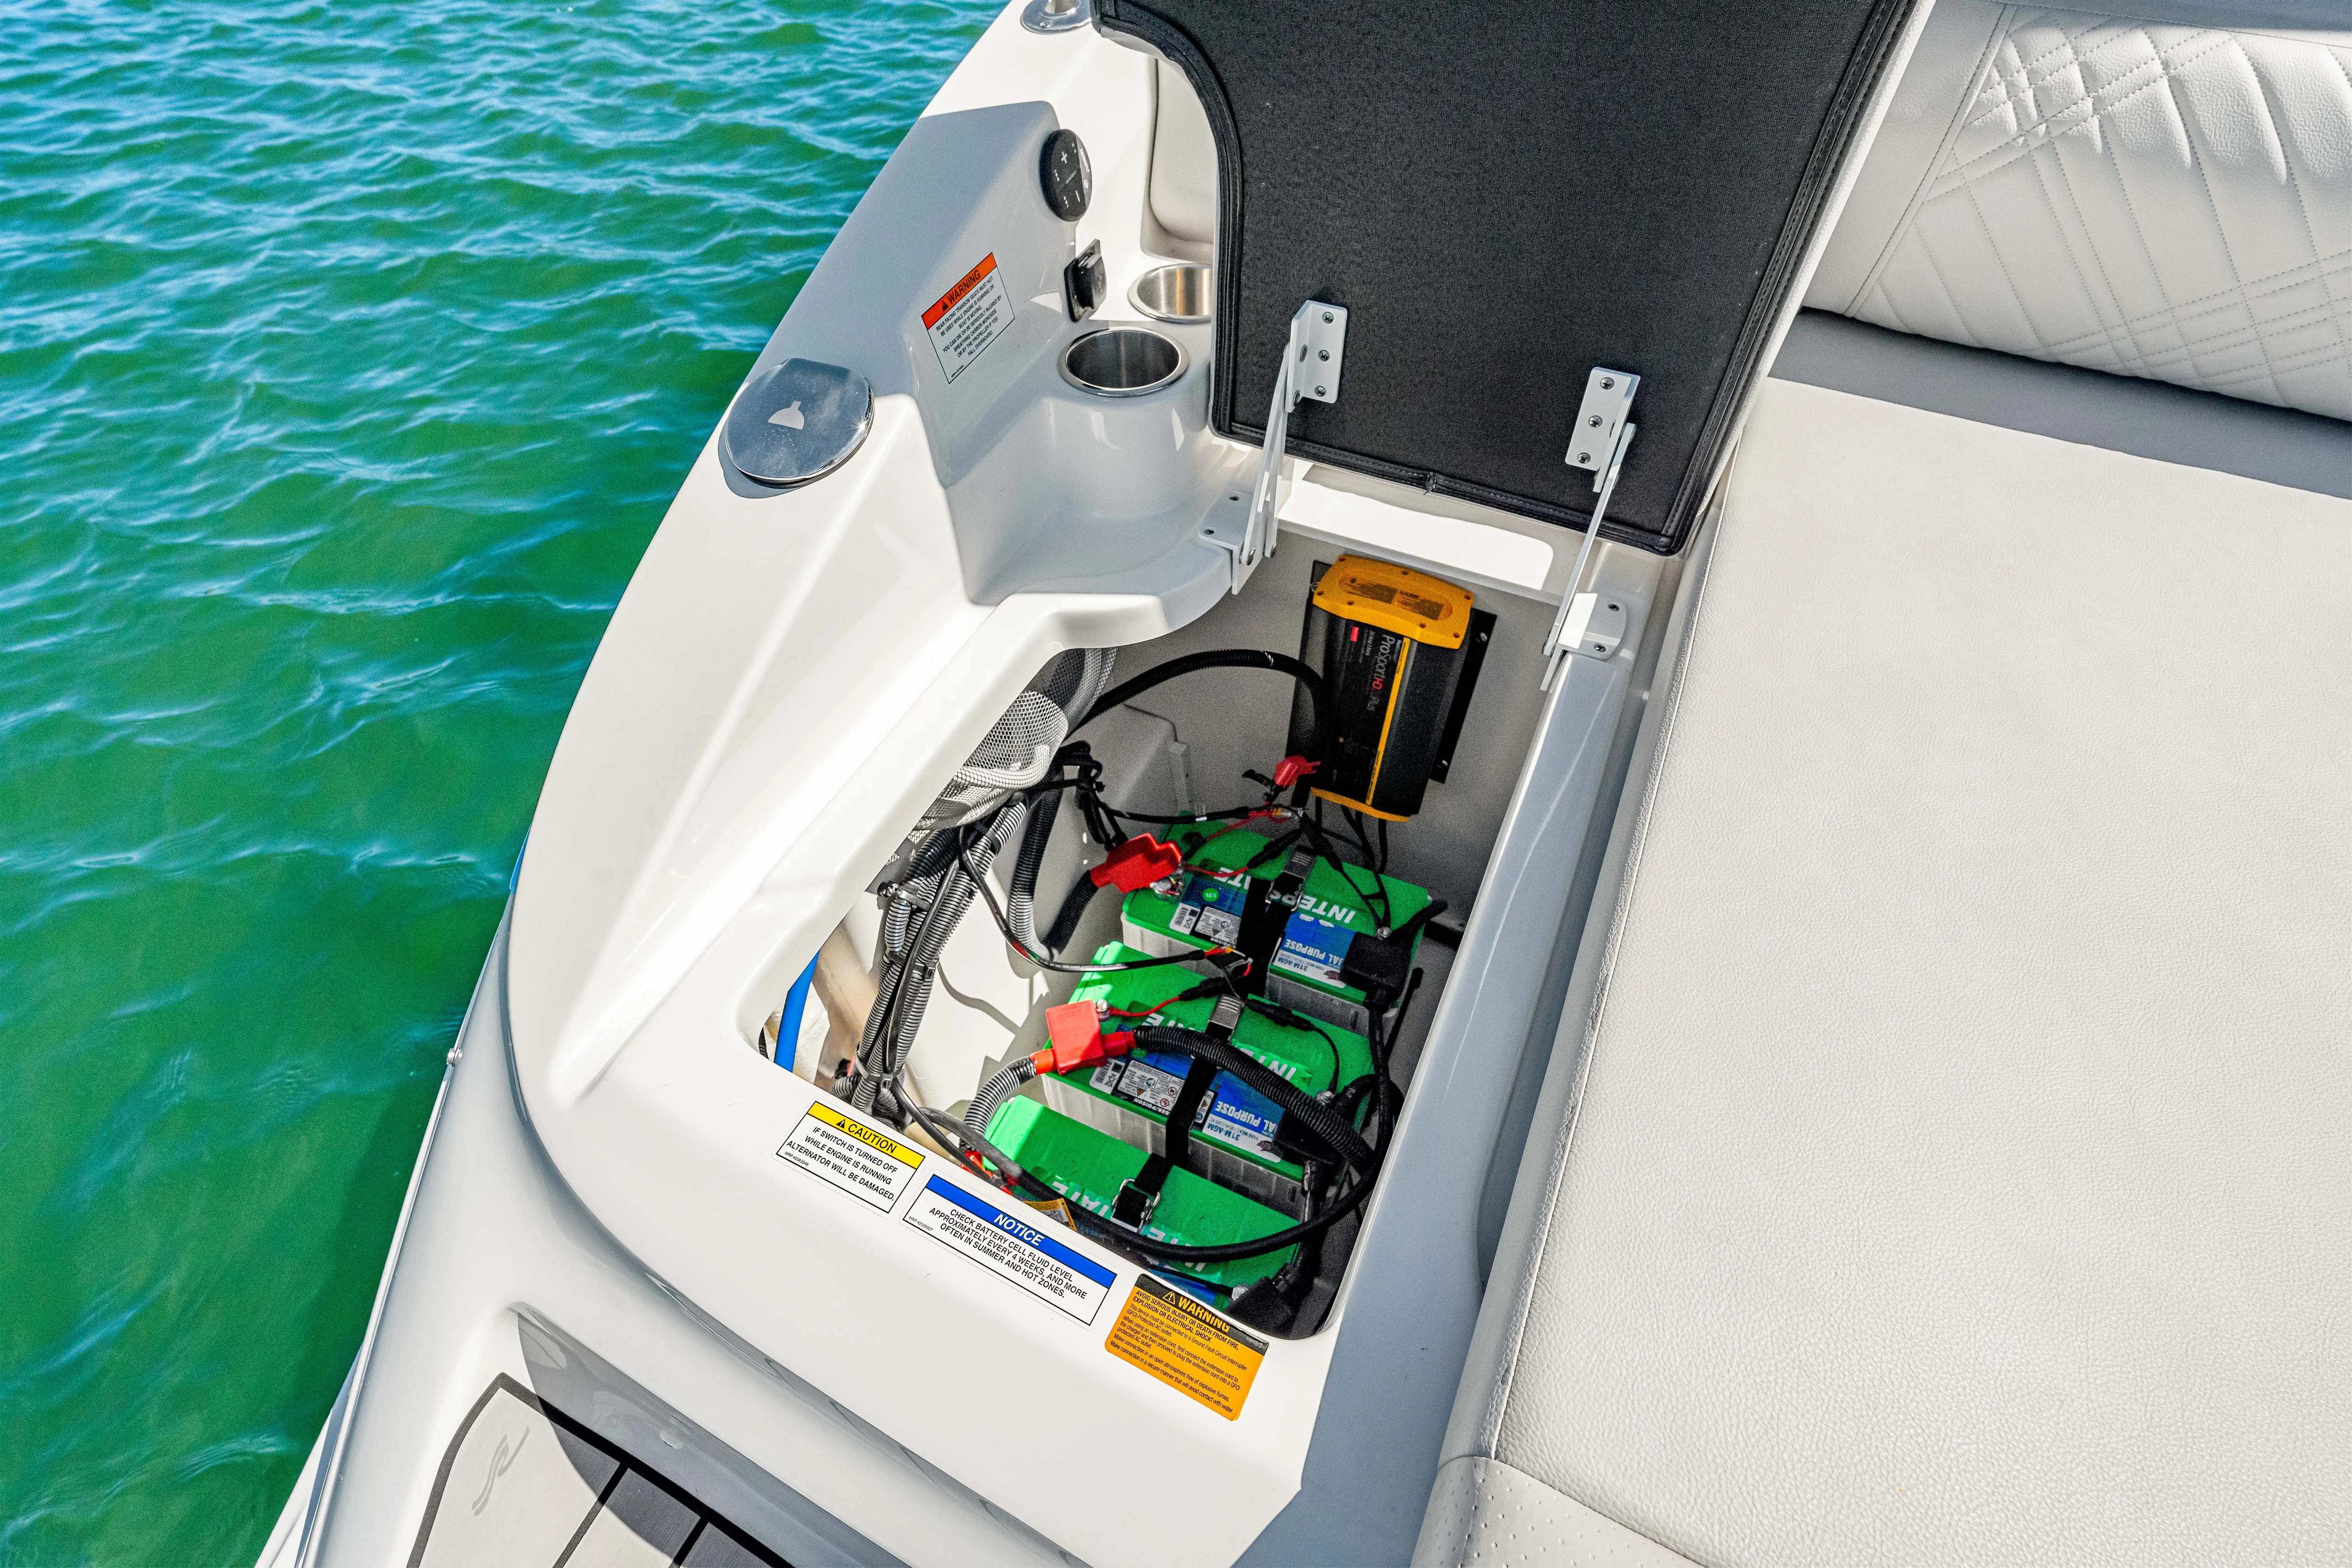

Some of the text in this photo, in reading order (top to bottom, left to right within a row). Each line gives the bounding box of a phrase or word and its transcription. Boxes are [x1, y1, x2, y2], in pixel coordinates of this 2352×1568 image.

[946, 270, 981, 304] WARNING
[936, 321, 946, 332] REAR
[945, 310, 956, 324] FACING
[955, 297, 970, 313] TRANSOM
[969, 289, 979, 300] SEATS
[945, 322, 954, 333] USED
[953, 313, 963, 325] WHILE
[962, 303, 974, 316] ENGINE
[977, 288, 990, 302] RUNNING
[958, 318, 967, 329] BOAT
[970, 310, 985, 327] SERIOUSLY
[954, 334, 971, 352] BREATHING
[970, 323, 983, 336] CARBON
[972, 325, 989, 343] PROPELLER
[1283, 939, 1326, 960] PURPOSE
[1214, 1100, 1262, 1127] PURPOSE
[805, 1135, 827, 1151] WHILE
[826, 1147, 853, 1164] ENGINE
[859, 1164, 892, 1185] RUNNING
[820, 1130, 847, 1148] SWITCH
[855, 1147, 883, 1166] TURNED
[883, 1163, 898, 1173] OFF
[848, 1123, 897, 1154] CAUTION
[786, 1140, 894, 1201] ALTERNATOR WILL BE DAMAGED.
[793, 1156, 809, 1166] #2063346
[917, 1221, 933, 1231] #2028927
[950, 1209, 1073, 1282] CHECK BATTERY CELL FLUID LEVEL
[993, 1213, 1045, 1246] NOTICE
[929, 1208, 988, 1242] APPROXIMATELY
[987, 1239, 1013, 1256] EVERY
[1018, 1256, 1045, 1277] WEEKS,
[1046, 1273, 1064, 1286] AND
[1064, 1282, 1088, 1299] MORE
[940, 1223, 1065, 1298] OFTEN IN SUMMER AND HOT ZONES.
[1116, 1327, 1136, 1339] protected
[1126, 1308, 1138, 1319] (GFCI)
[1137, 1314, 1156, 1328] Protected
[1132, 1296, 1160, 1314] EXPLOSION
[1166, 1314, 1194, 1334] ELECTRICAL
[1194, 1329, 1212, 1343] SHOCK
[1136, 1290, 1151, 1301] AVOID
[1151, 1298, 1171, 1313] SERIOUS
[1171, 1309, 1189, 1322] INJURY
[1196, 1322, 1213, 1335] DEATH
[1212, 1331, 1227, 1343] FROM
[1227, 1339, 1239, 1351] FIRE,
[1178, 1296, 1231, 1333] WARNING
[1123, 1315, 1134, 1325] When
[1134, 1322, 1144, 1331] using
[1149, 1331, 1168, 1343] extension
[1167, 1340, 1177, 1349] cord,
[1184, 1350, 1200, 1361] connect
[1206, 1362, 1225, 1375] extension
[1126, 1325, 1141, 1336] charger
[1156, 1342, 1173, 1353] proceed
[1176, 1353, 1186, 1361] plug
[1192, 1361, 1210, 1374] extension
[1230, 1382, 1241, 1391] GFCI
[1137, 1308, 1150, 1318] device
[1164, 1323, 1184, 1337] connected
[1191, 1337, 1206, 1348] Ground
[1205, 1345, 1215, 1354] Fault
[1215, 1350, 1228, 1361] Circuit
[1227, 1356, 1248, 1371] Interrupter
[1110, 1340, 1121, 1350] Make
[1120, 1347, 1141, 1361] connection
[1147, 1362, 1160, 1372] secure
[1160, 1369, 1175, 1380] manner
[1188, 1385, 1200, 1394] avoid
[1199, 1391, 1214, 1402] contact
[1222, 1404, 1233, 1414] water.
[1113, 1333, 1125, 1343] Make
[1124, 1340, 1144, 1354] connection
[1154, 1356, 1164, 1365] open
[1163, 1362, 1186, 1377] atmosphere
[1186, 1374, 1194, 1382] free
[1199, 1382, 1216, 1394] explosive
[1216, 1391, 1229, 1402] fumes.
